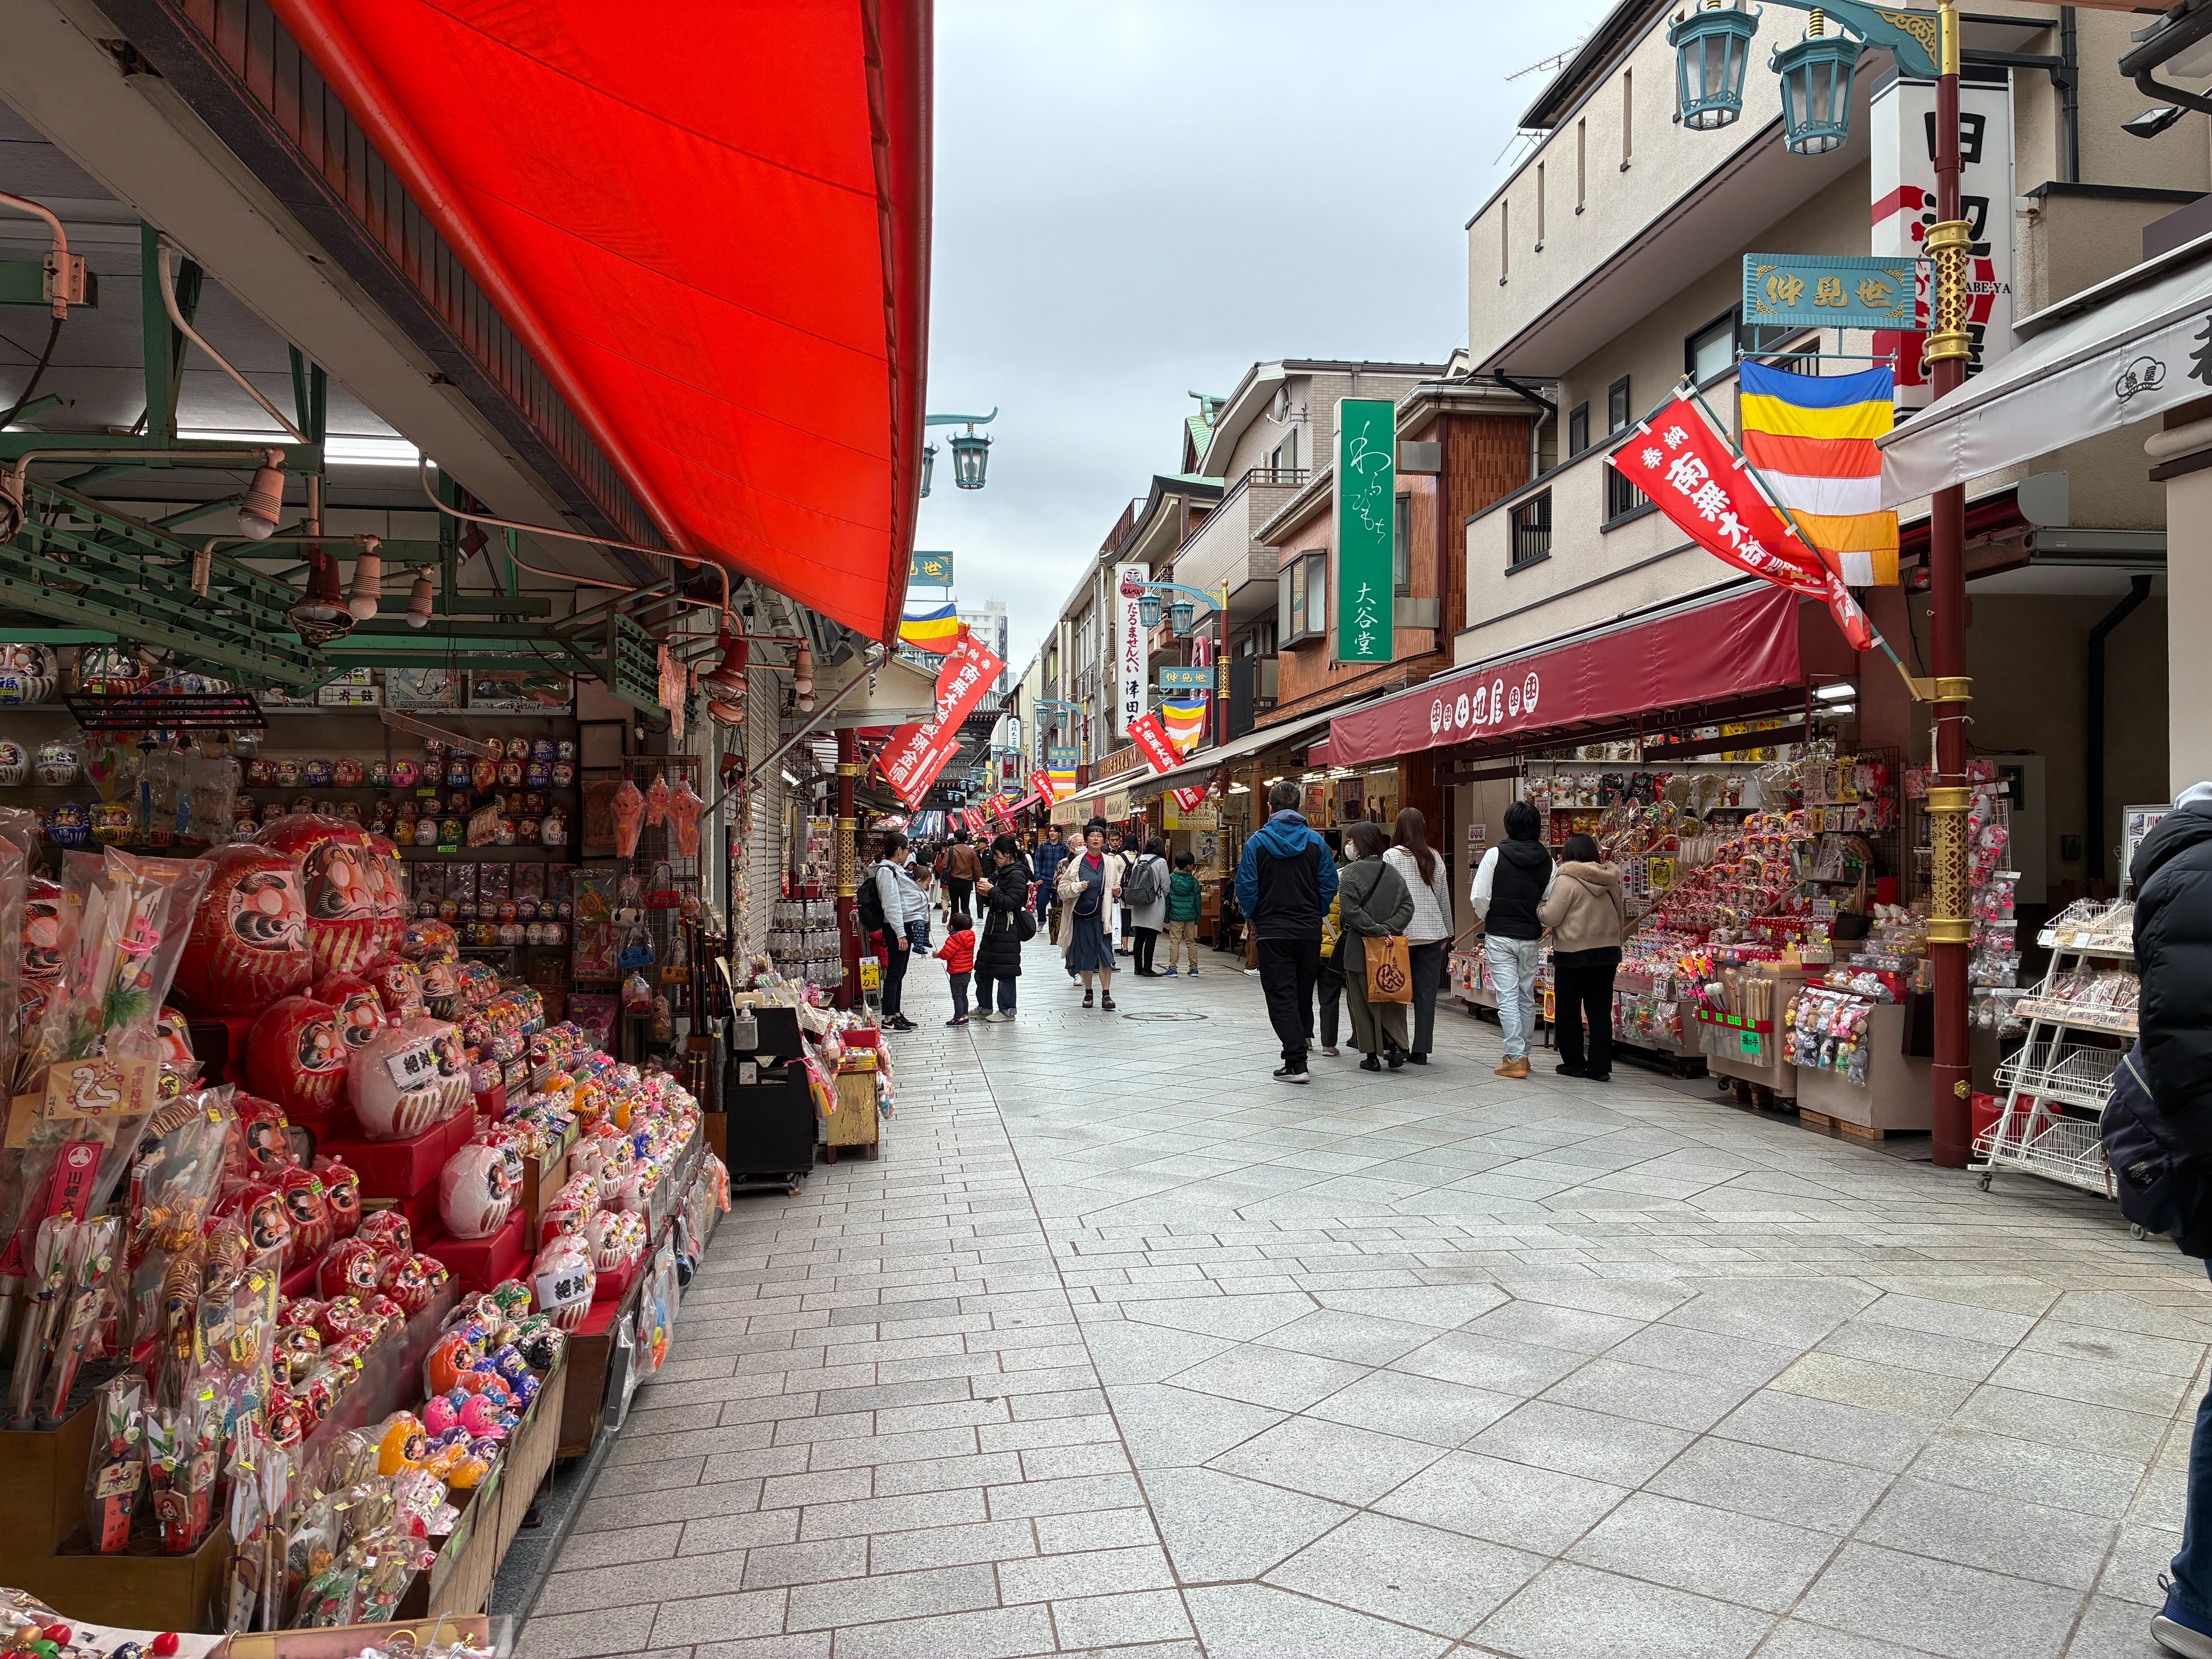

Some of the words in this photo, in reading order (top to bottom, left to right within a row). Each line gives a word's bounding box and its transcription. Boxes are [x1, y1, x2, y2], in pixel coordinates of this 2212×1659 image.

[1765, 274, 1893, 308] 仲見世
[1965, 281, 2012, 294] ABE-YA
[1354, 581, 1378, 655] 大谷堂
[1126, 602, 1140, 673] だるませんべい
[1166, 672, 1207, 683] 仲見世
[1455, 678, 1504, 728] 田辺屋
[862, 967, 870, 987] 木刀
[869, 968, 878, 986] つえ
[1742, 1034, 1759, 1047] 孫の手
[59, 1171, 83, 1211] 川崎大
